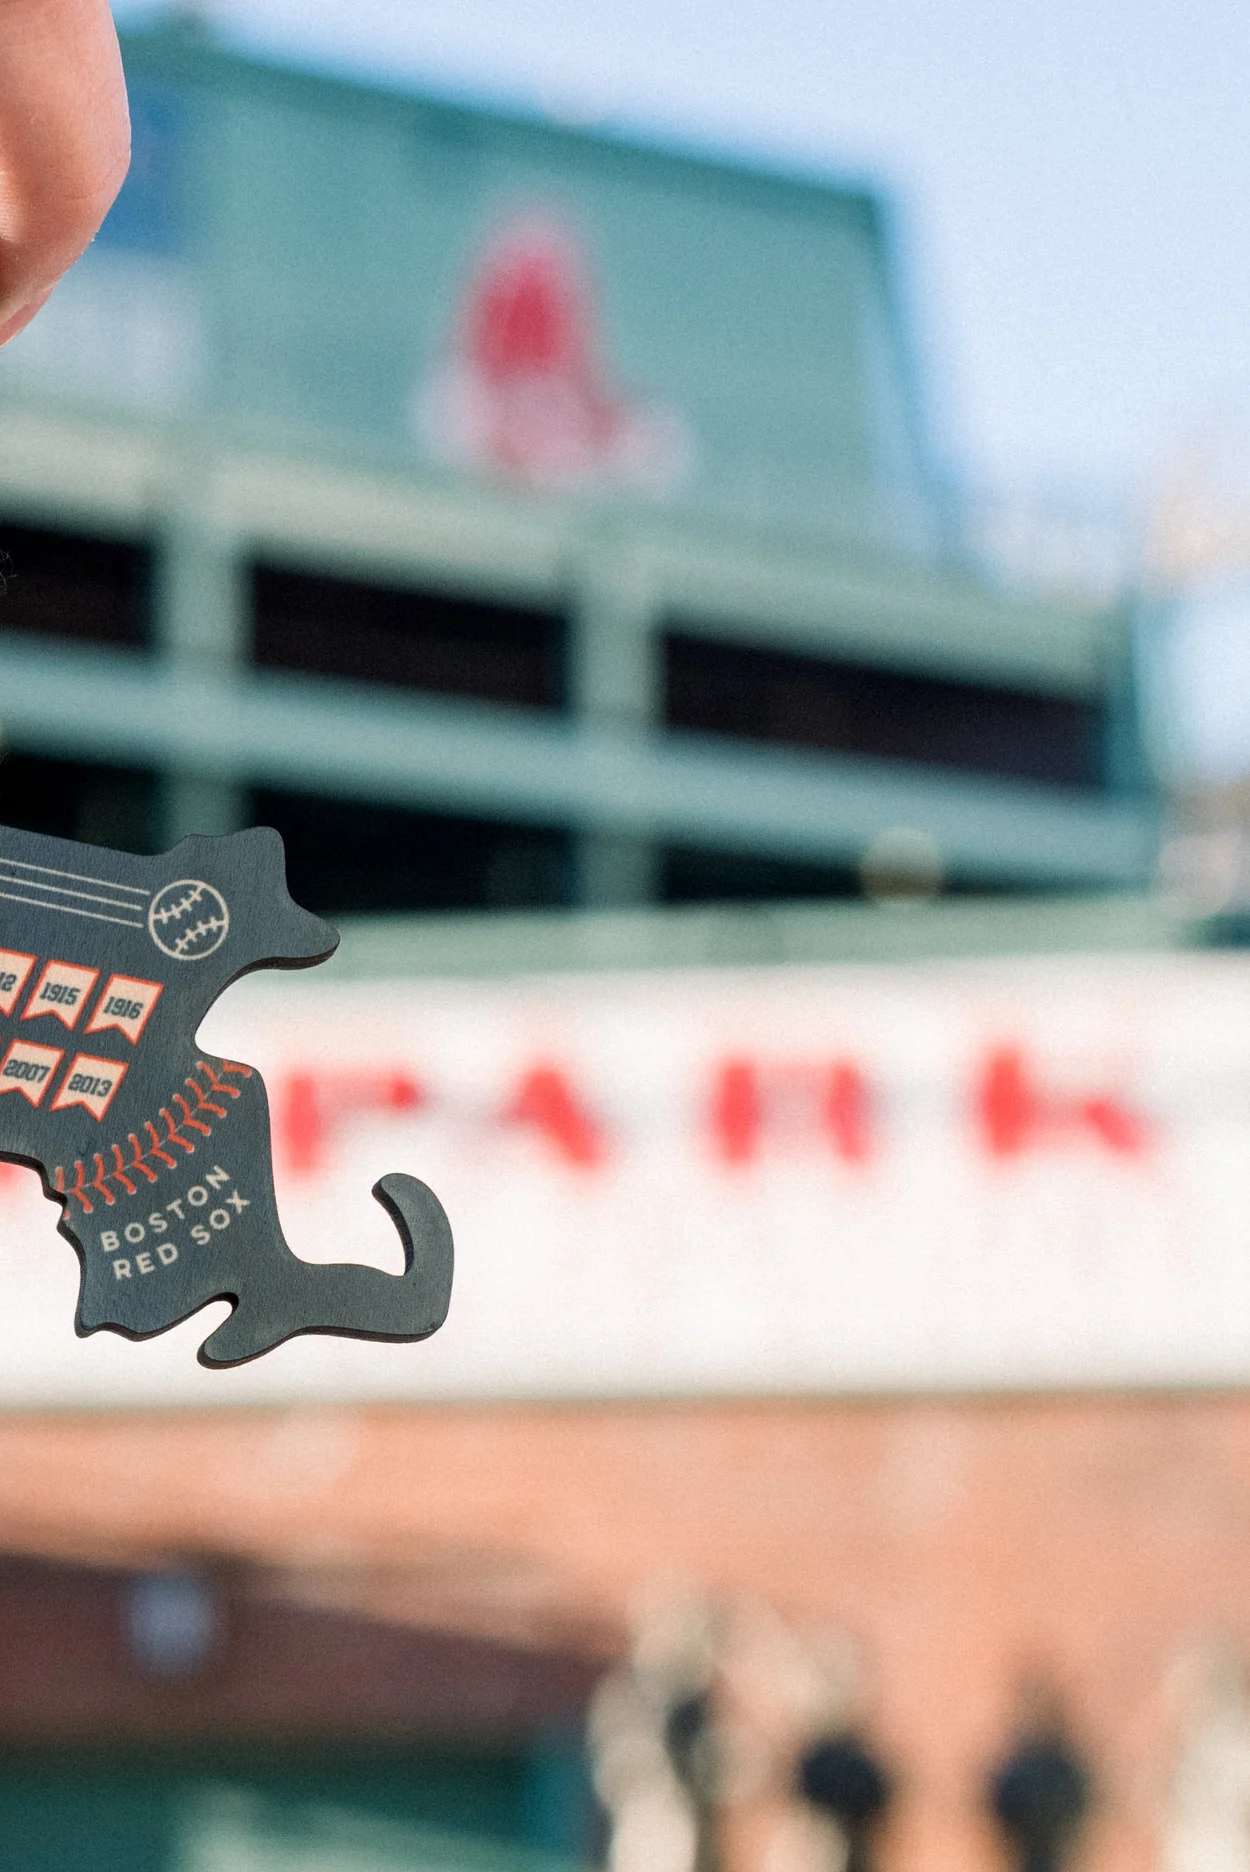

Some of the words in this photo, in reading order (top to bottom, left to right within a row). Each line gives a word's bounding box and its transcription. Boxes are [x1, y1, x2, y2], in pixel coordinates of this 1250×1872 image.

[39, 981, 81, 1006] 1915
[103, 995, 143, 1019] 1916
[2, 1059, 51, 1084] 2007
[67, 1073, 112, 1098] 2013
[101, 1166, 231, 1252] BOSTON
[113, 1243, 178, 1280] RED
[191, 1190, 250, 1245] SOX
